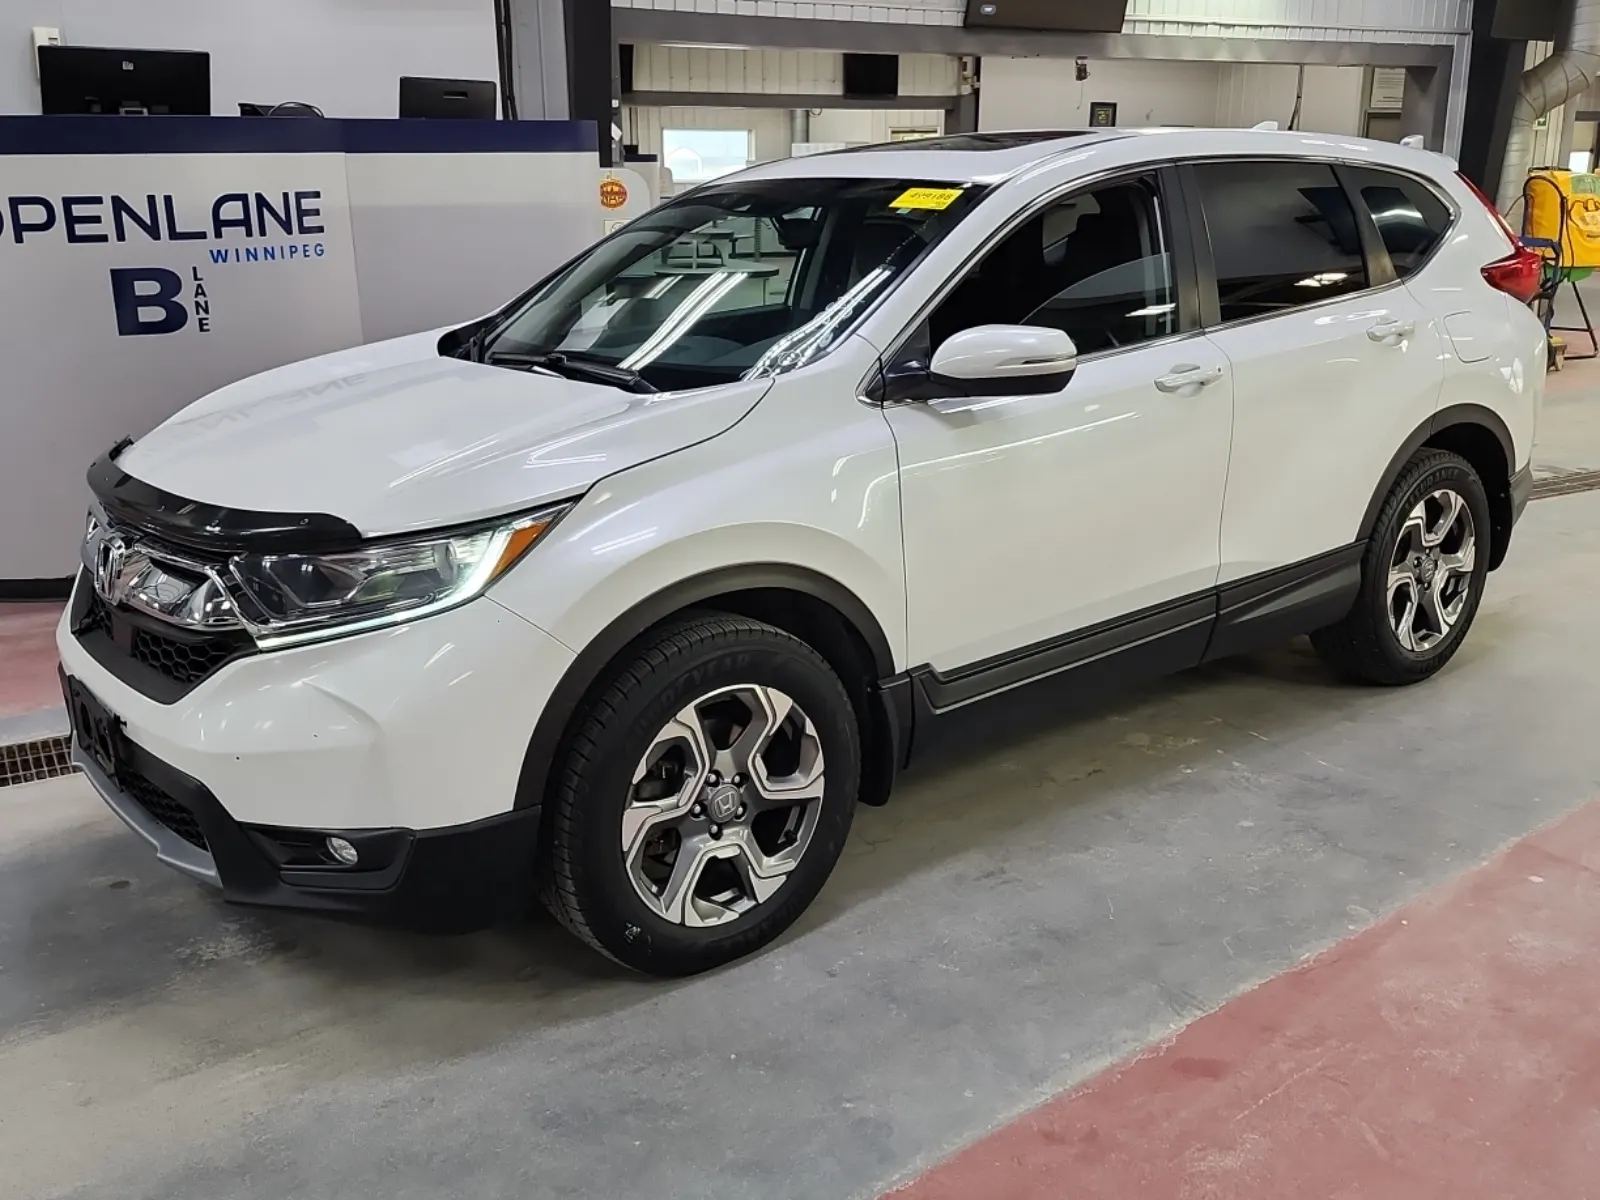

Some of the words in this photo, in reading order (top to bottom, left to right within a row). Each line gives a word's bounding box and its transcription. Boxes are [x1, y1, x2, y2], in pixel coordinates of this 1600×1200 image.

[0, 190, 325, 244] PENLANE
[209, 243, 325, 264] WINNIPEG
[109, 267, 188, 336] B
[192, 266, 211, 333] LANE
